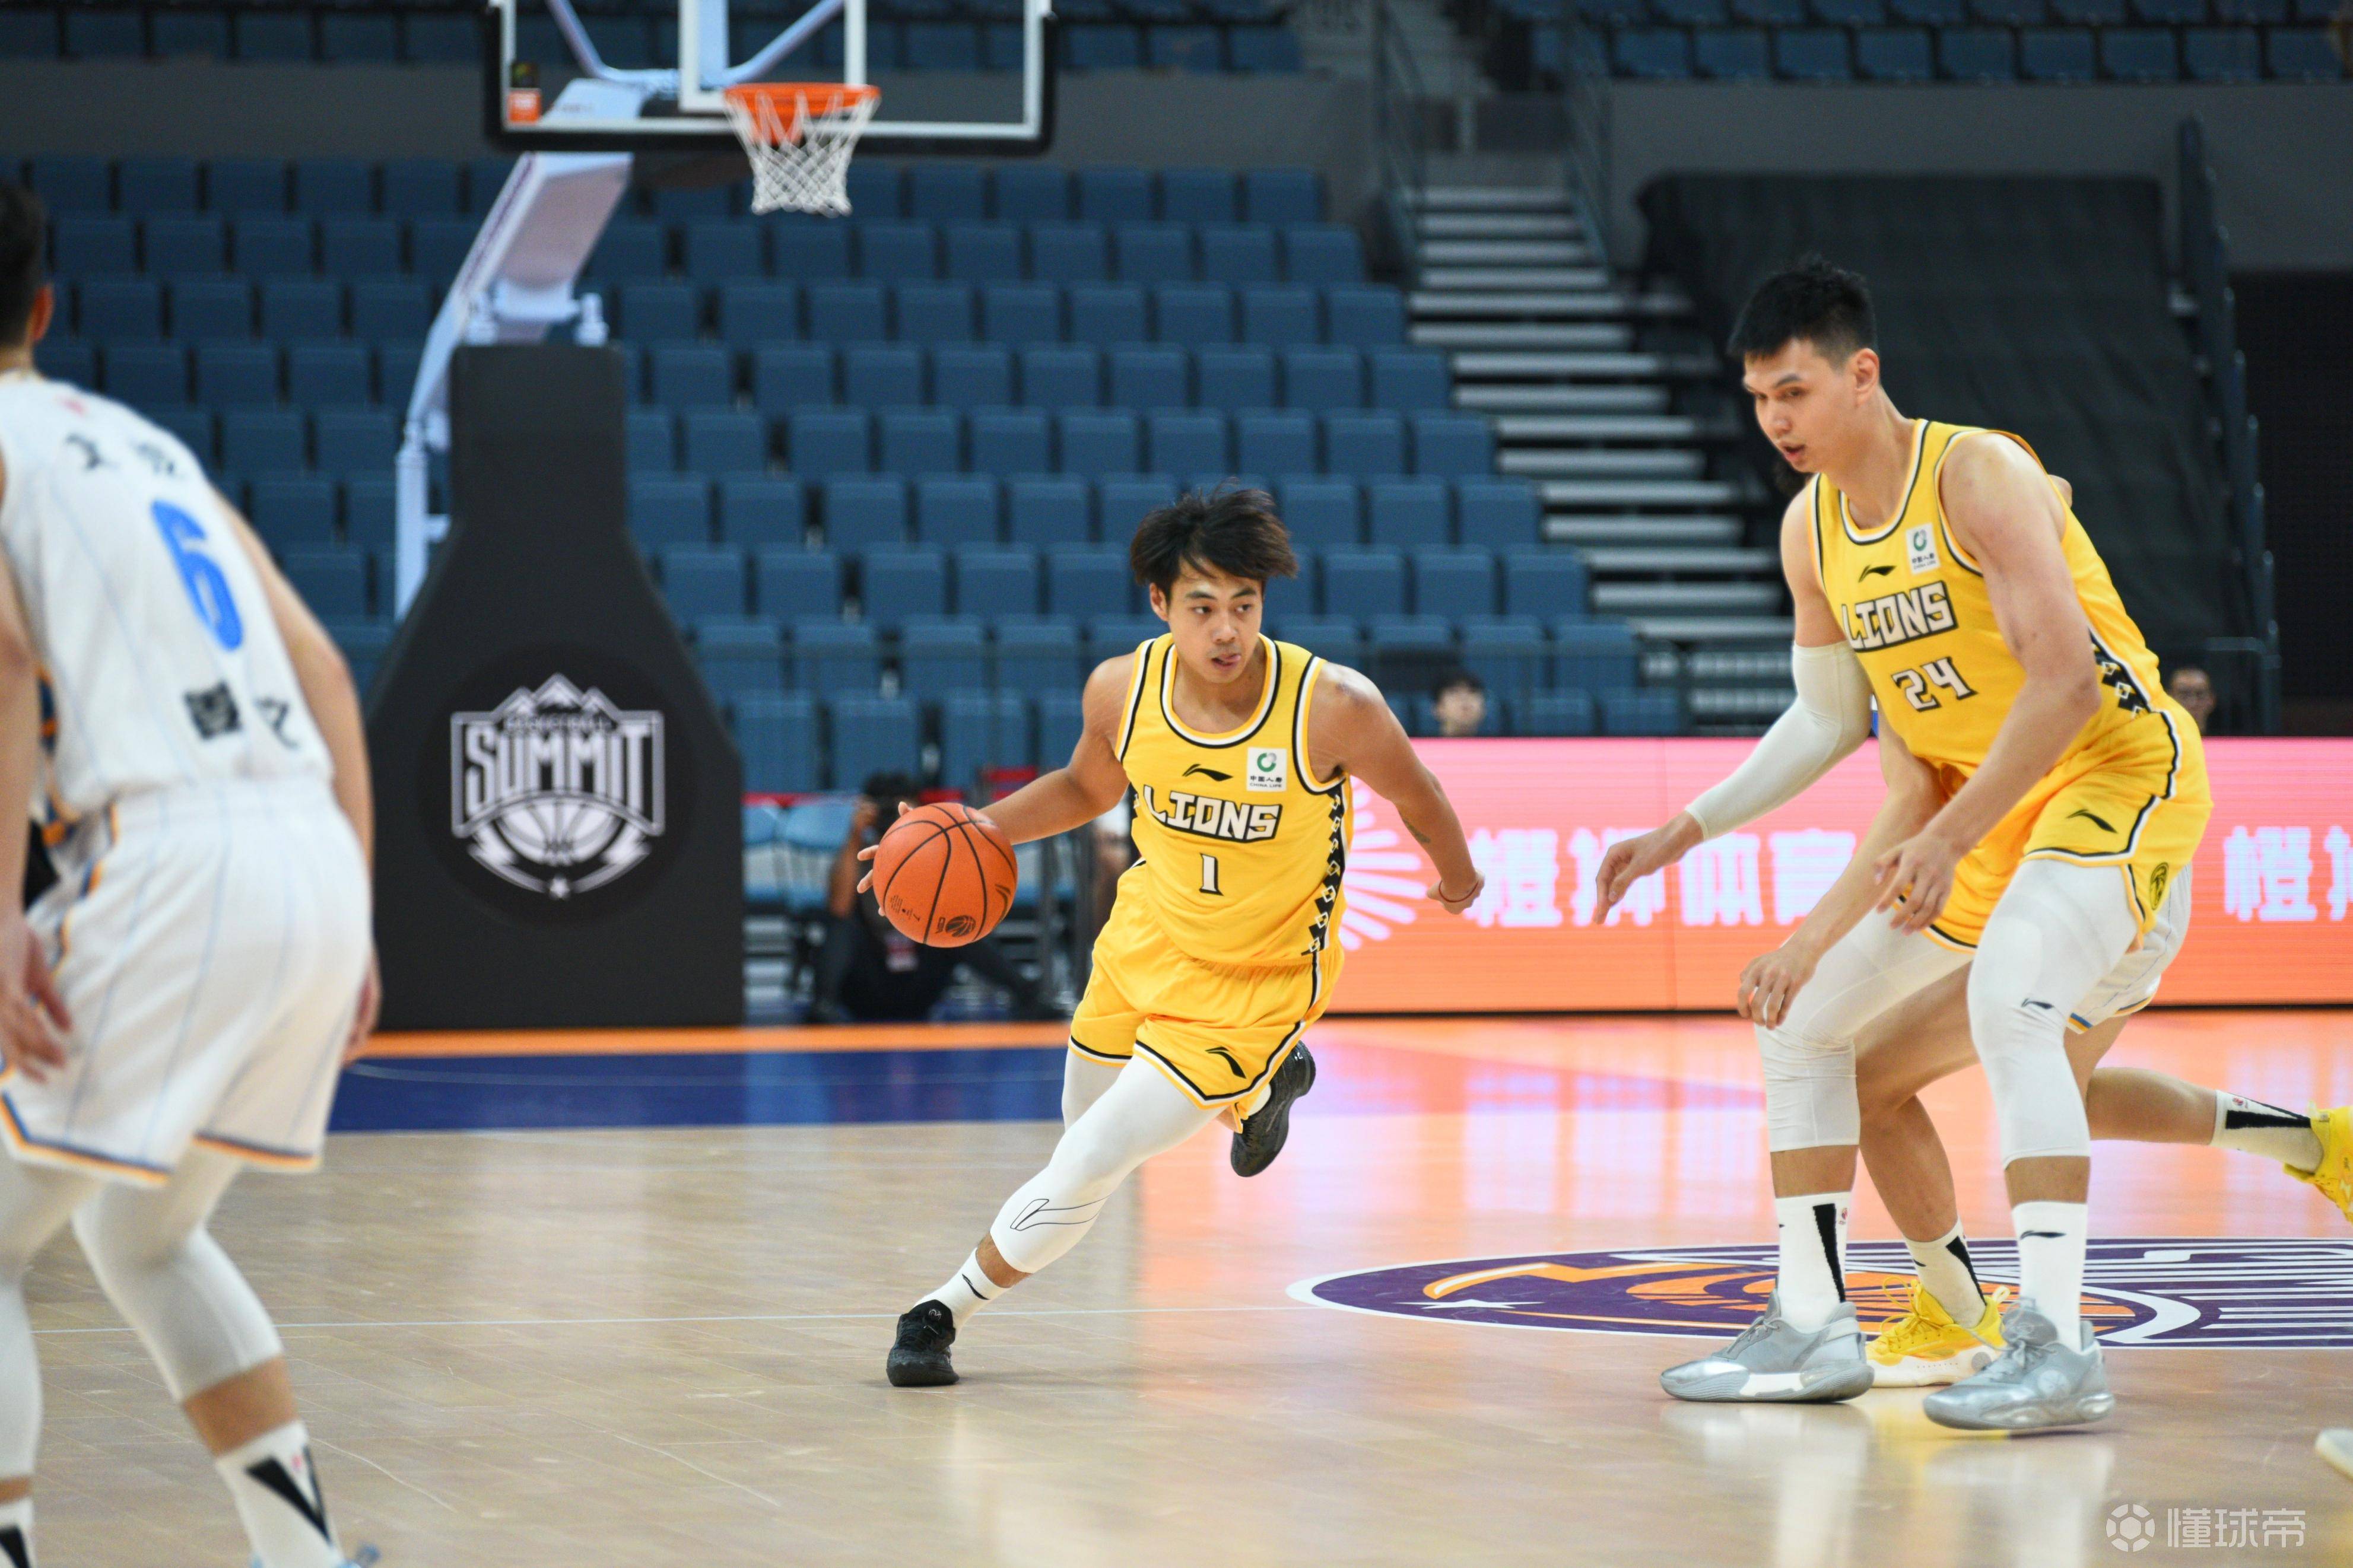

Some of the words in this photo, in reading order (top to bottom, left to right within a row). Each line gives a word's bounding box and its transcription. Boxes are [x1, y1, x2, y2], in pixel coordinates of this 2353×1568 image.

[150, 500, 244, 653] 6
[1841, 580, 1960, 653] LIONS
[1891, 656, 1979, 713] 24
[465, 723, 651, 816] SUMMIT
[1143, 784, 1283, 843] LIONS
[1199, 853, 1224, 896] 1
